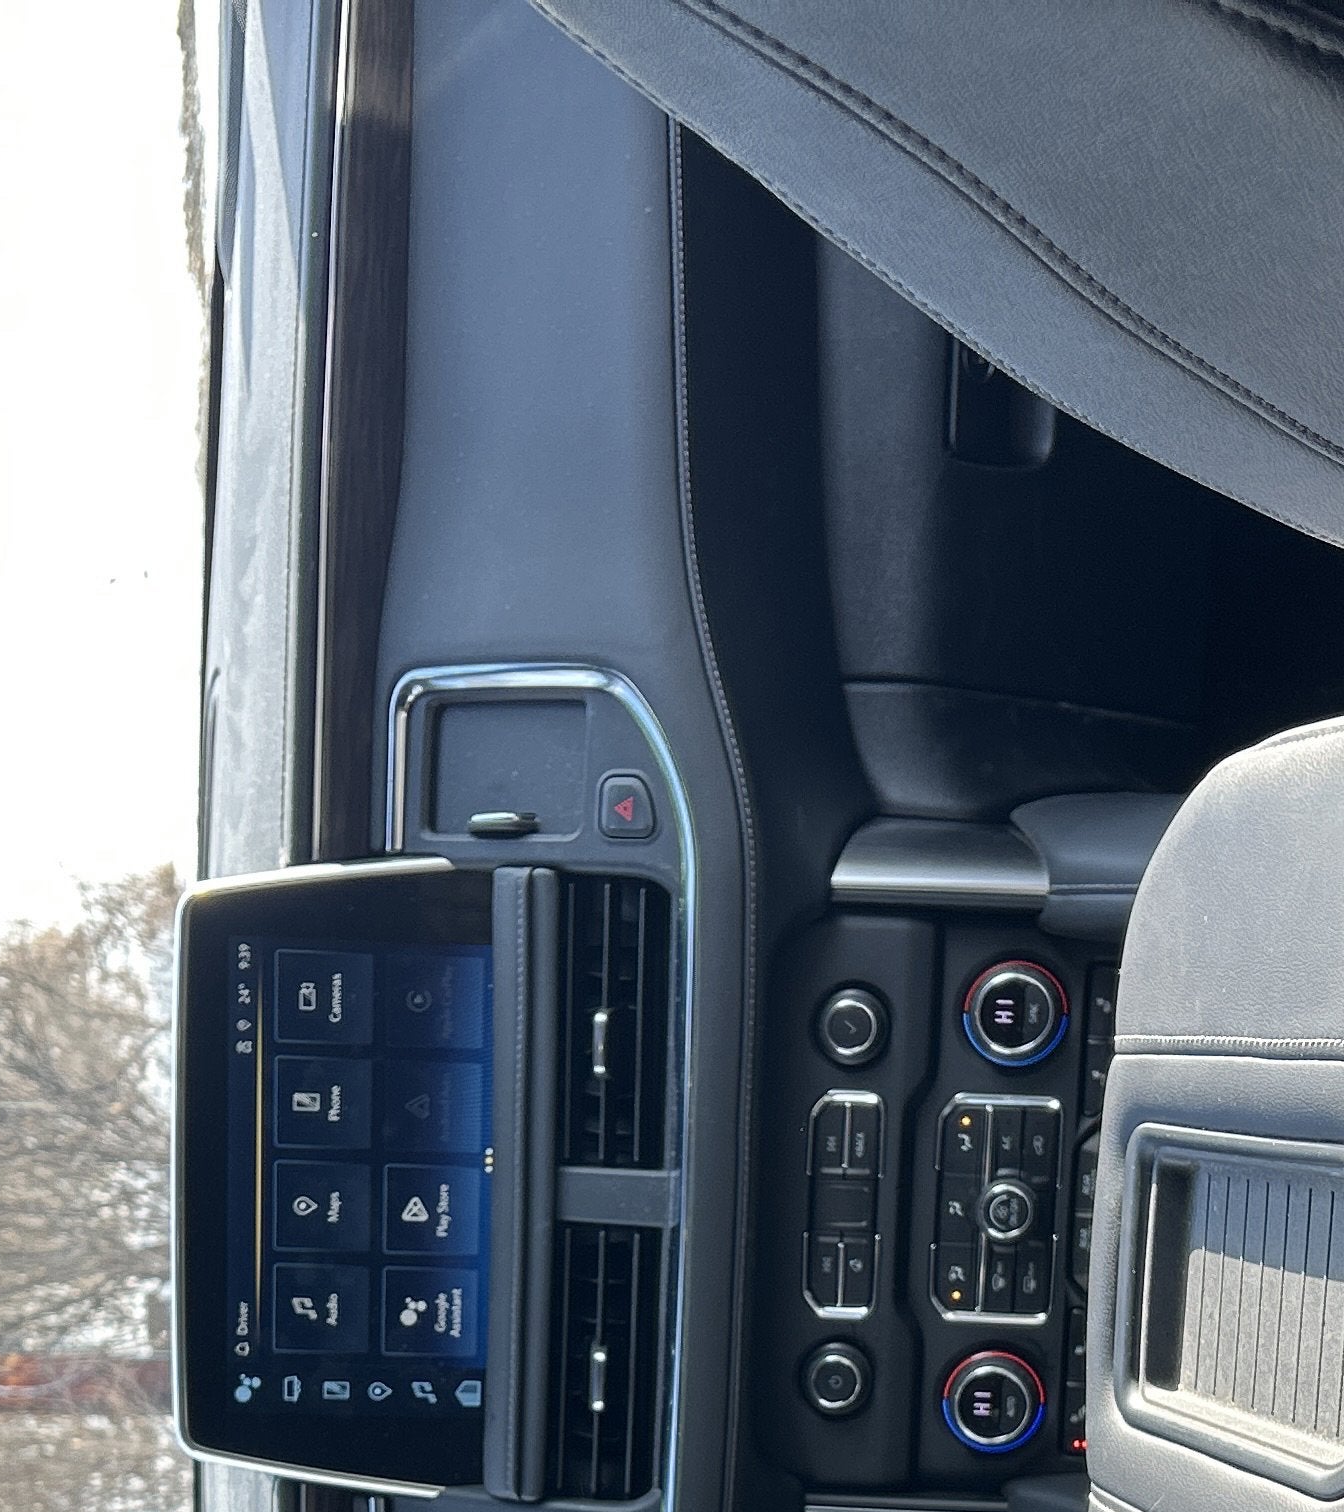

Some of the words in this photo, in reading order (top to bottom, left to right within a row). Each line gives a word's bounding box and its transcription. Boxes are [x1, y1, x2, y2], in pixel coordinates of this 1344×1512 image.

[238, 943, 252, 970] 9:39
[328, 973, 342, 1022] Cameras
[994, 999, 1014, 1024] HI
[328, 1085, 342, 1122] Phone
[328, 1192, 342, 1223] Maps
[436, 1184, 451, 1212] Store
[436, 1214, 452, 1237] Play
[236, 1301, 250, 1336] Driver
[327, 1293, 340, 1326] Audio
[434, 1293, 450, 1333] Google
[449, 1288, 464, 1338] Assistant
[972, 1392, 992, 1416] HI
